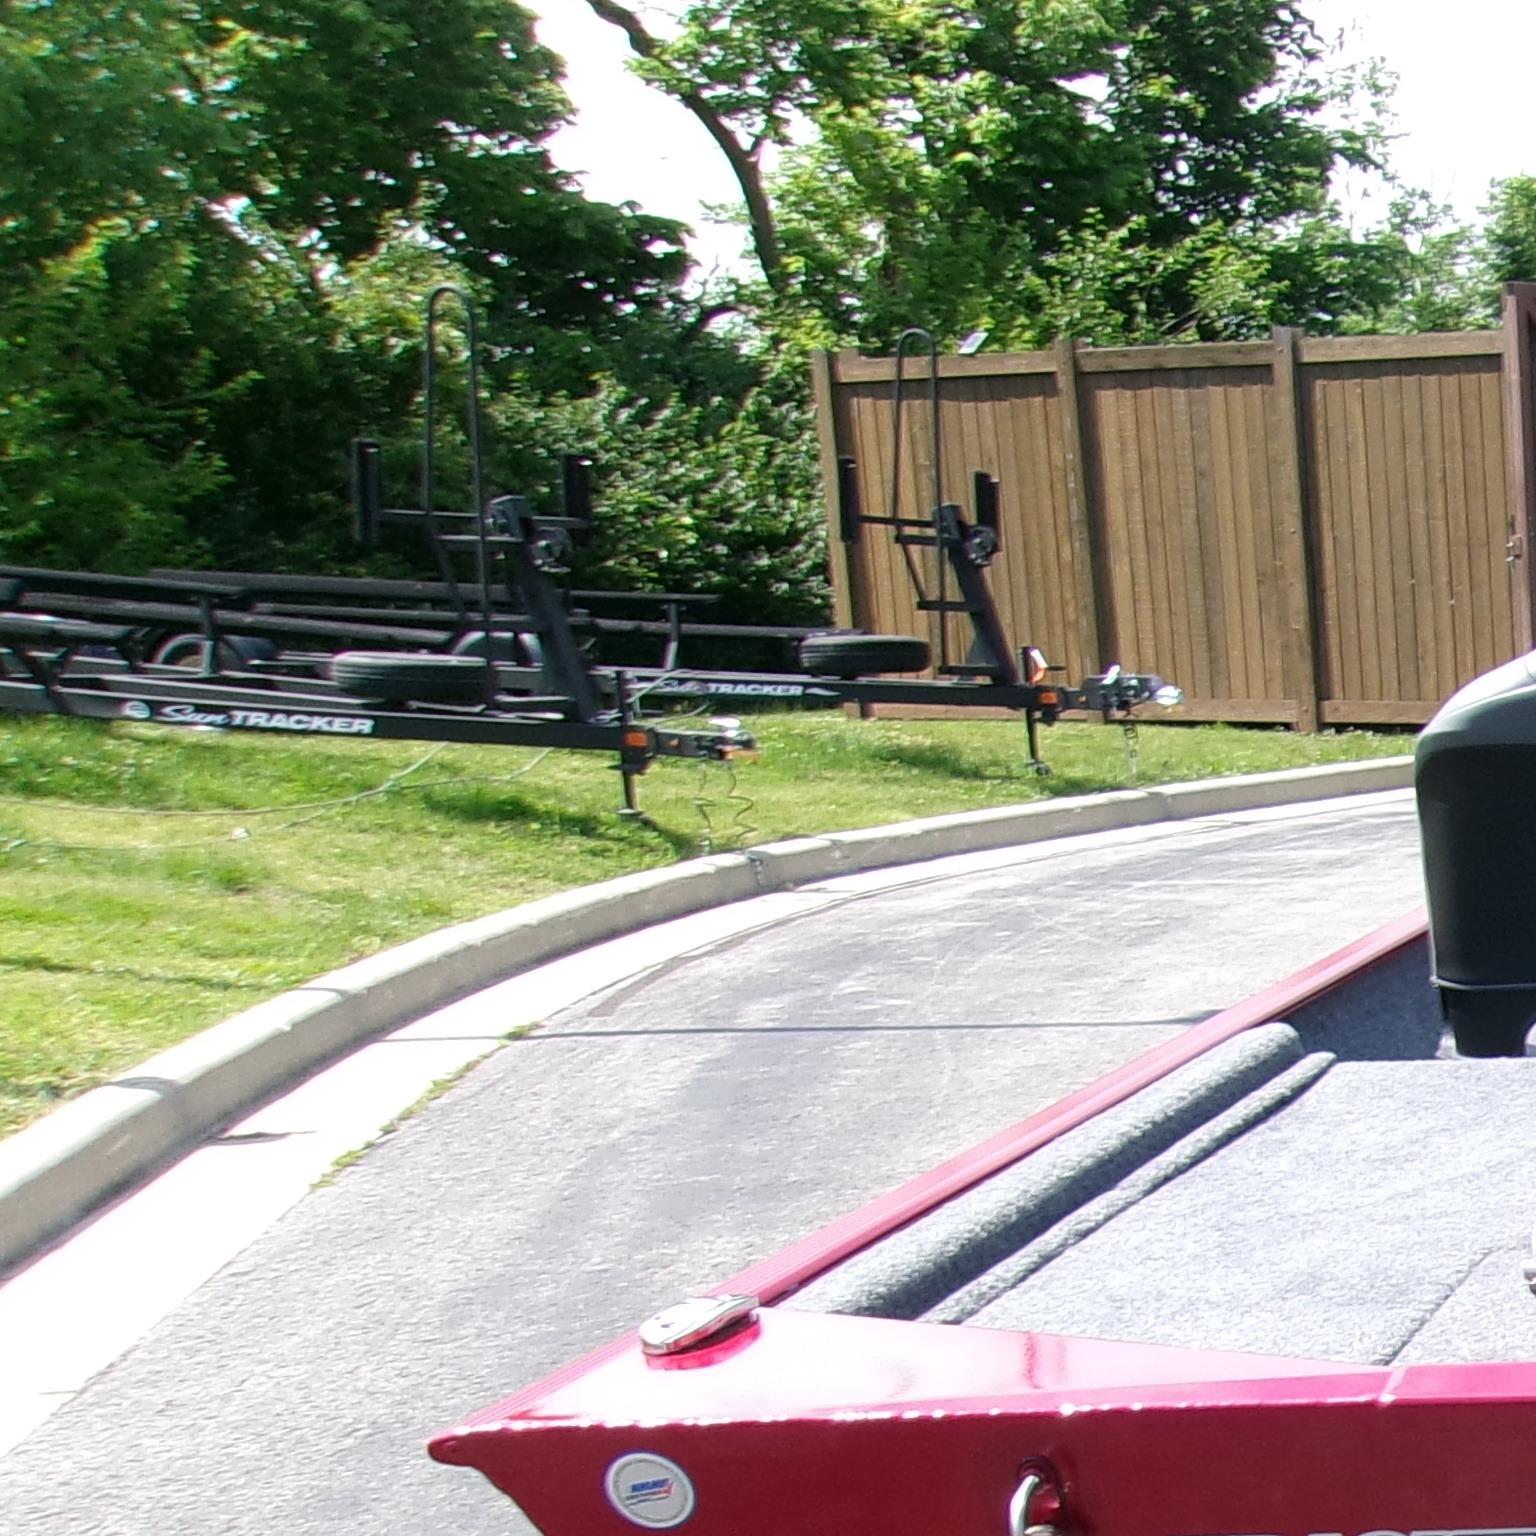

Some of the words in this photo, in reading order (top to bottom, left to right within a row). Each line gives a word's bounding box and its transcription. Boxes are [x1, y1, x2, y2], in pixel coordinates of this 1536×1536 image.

[706, 682, 804, 696] TRACKER
[160, 704, 230, 725] Sun
[229, 710, 375, 734] TRACKER
